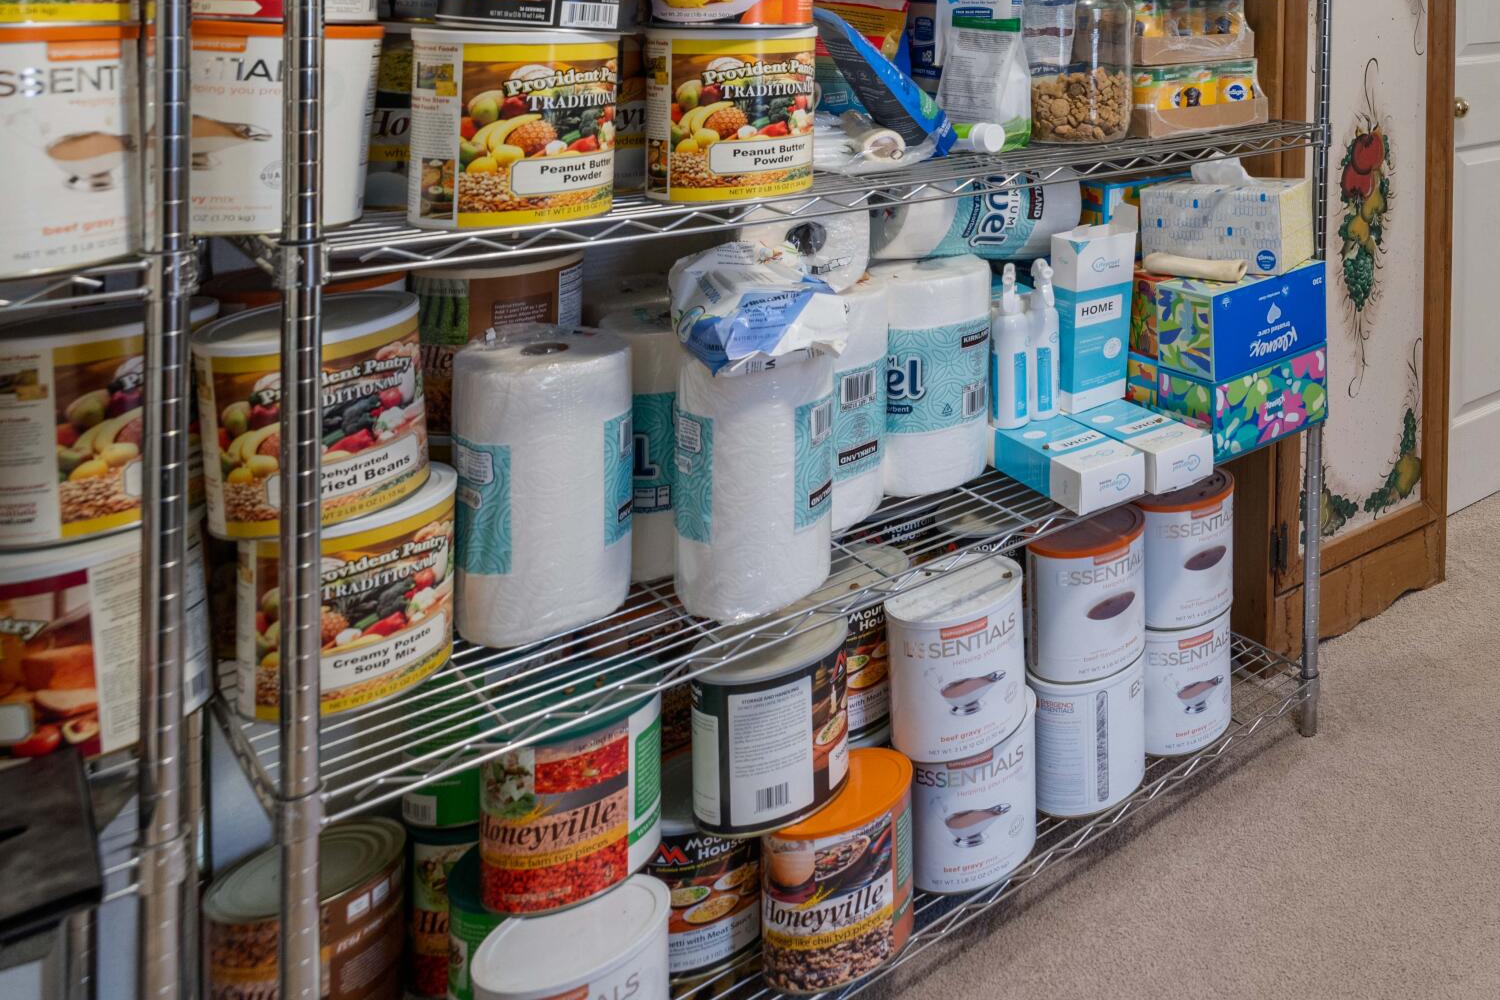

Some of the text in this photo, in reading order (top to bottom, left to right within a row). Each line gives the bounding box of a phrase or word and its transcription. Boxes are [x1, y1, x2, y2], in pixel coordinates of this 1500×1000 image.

[504, 68, 599, 97] Provident
[702, 60, 788, 86] Provident
[733, 141, 806, 158] Peanut Butter
[753, 153, 794, 167] Powder
[540, 157, 612, 176] Peanut Butter
[562, 170, 603, 184] Powder
[729, 186, 759, 196] NET WT
[1080, 300, 1114, 317] HOME
[1271, 321, 1290, 334] trusted
[1249, 327, 1298, 358] Kleenex
[363, 355, 412, 377] Pantry
[364, 454, 411, 482] Beans
[402, 534, 447, 560] Pantry
[1056, 550, 1143, 587] ESSENTIAL
[333, 626, 432, 670] Creamy Potato
[1147, 627, 1230, 666] ESSENTIALS
[354, 645, 417, 676] Soup Mix
[940, 728, 982, 743] beef gravy
[1175, 725, 1207, 739] beef gravy
[916, 744, 1024, 788] ESSENTIALS
[957, 784, 983, 799] Helping
[528, 839, 609, 868] ham tvp pieces
[943, 860, 984, 874] beef gravy
[765, 881, 884, 932] Honeyville
[687, 927, 729, 946] with Meat
[812, 913, 881, 945] chili tvp pieces
